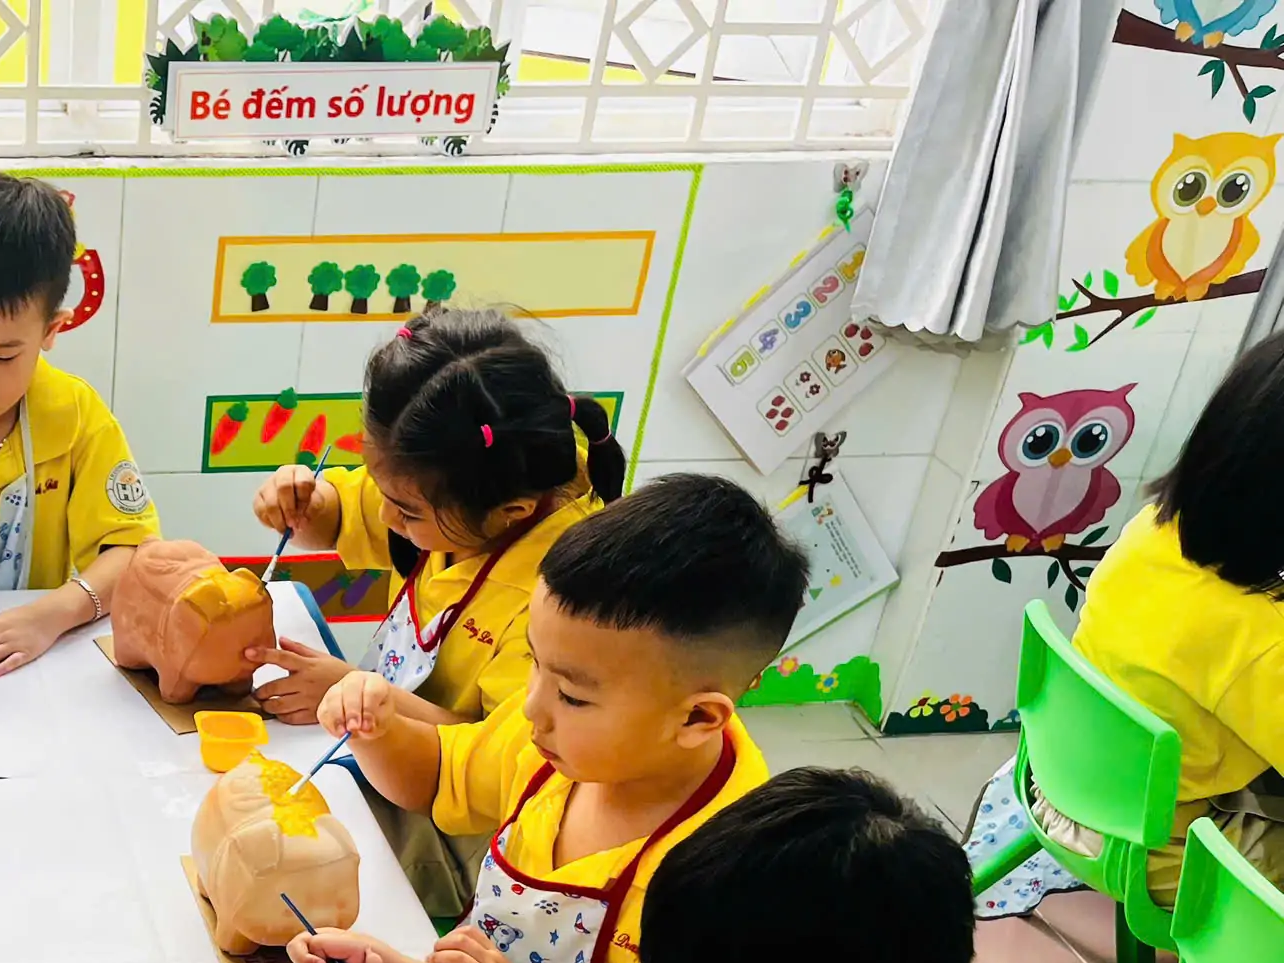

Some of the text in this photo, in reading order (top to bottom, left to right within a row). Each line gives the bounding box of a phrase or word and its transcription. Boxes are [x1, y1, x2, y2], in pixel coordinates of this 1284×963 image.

[189, 83, 476, 125] Bé đếm số lượng
[812, 275, 839, 304] 2
[784, 300, 812, 329] 3
[758, 328, 779, 354] 4
[730, 350, 755, 377] 5
